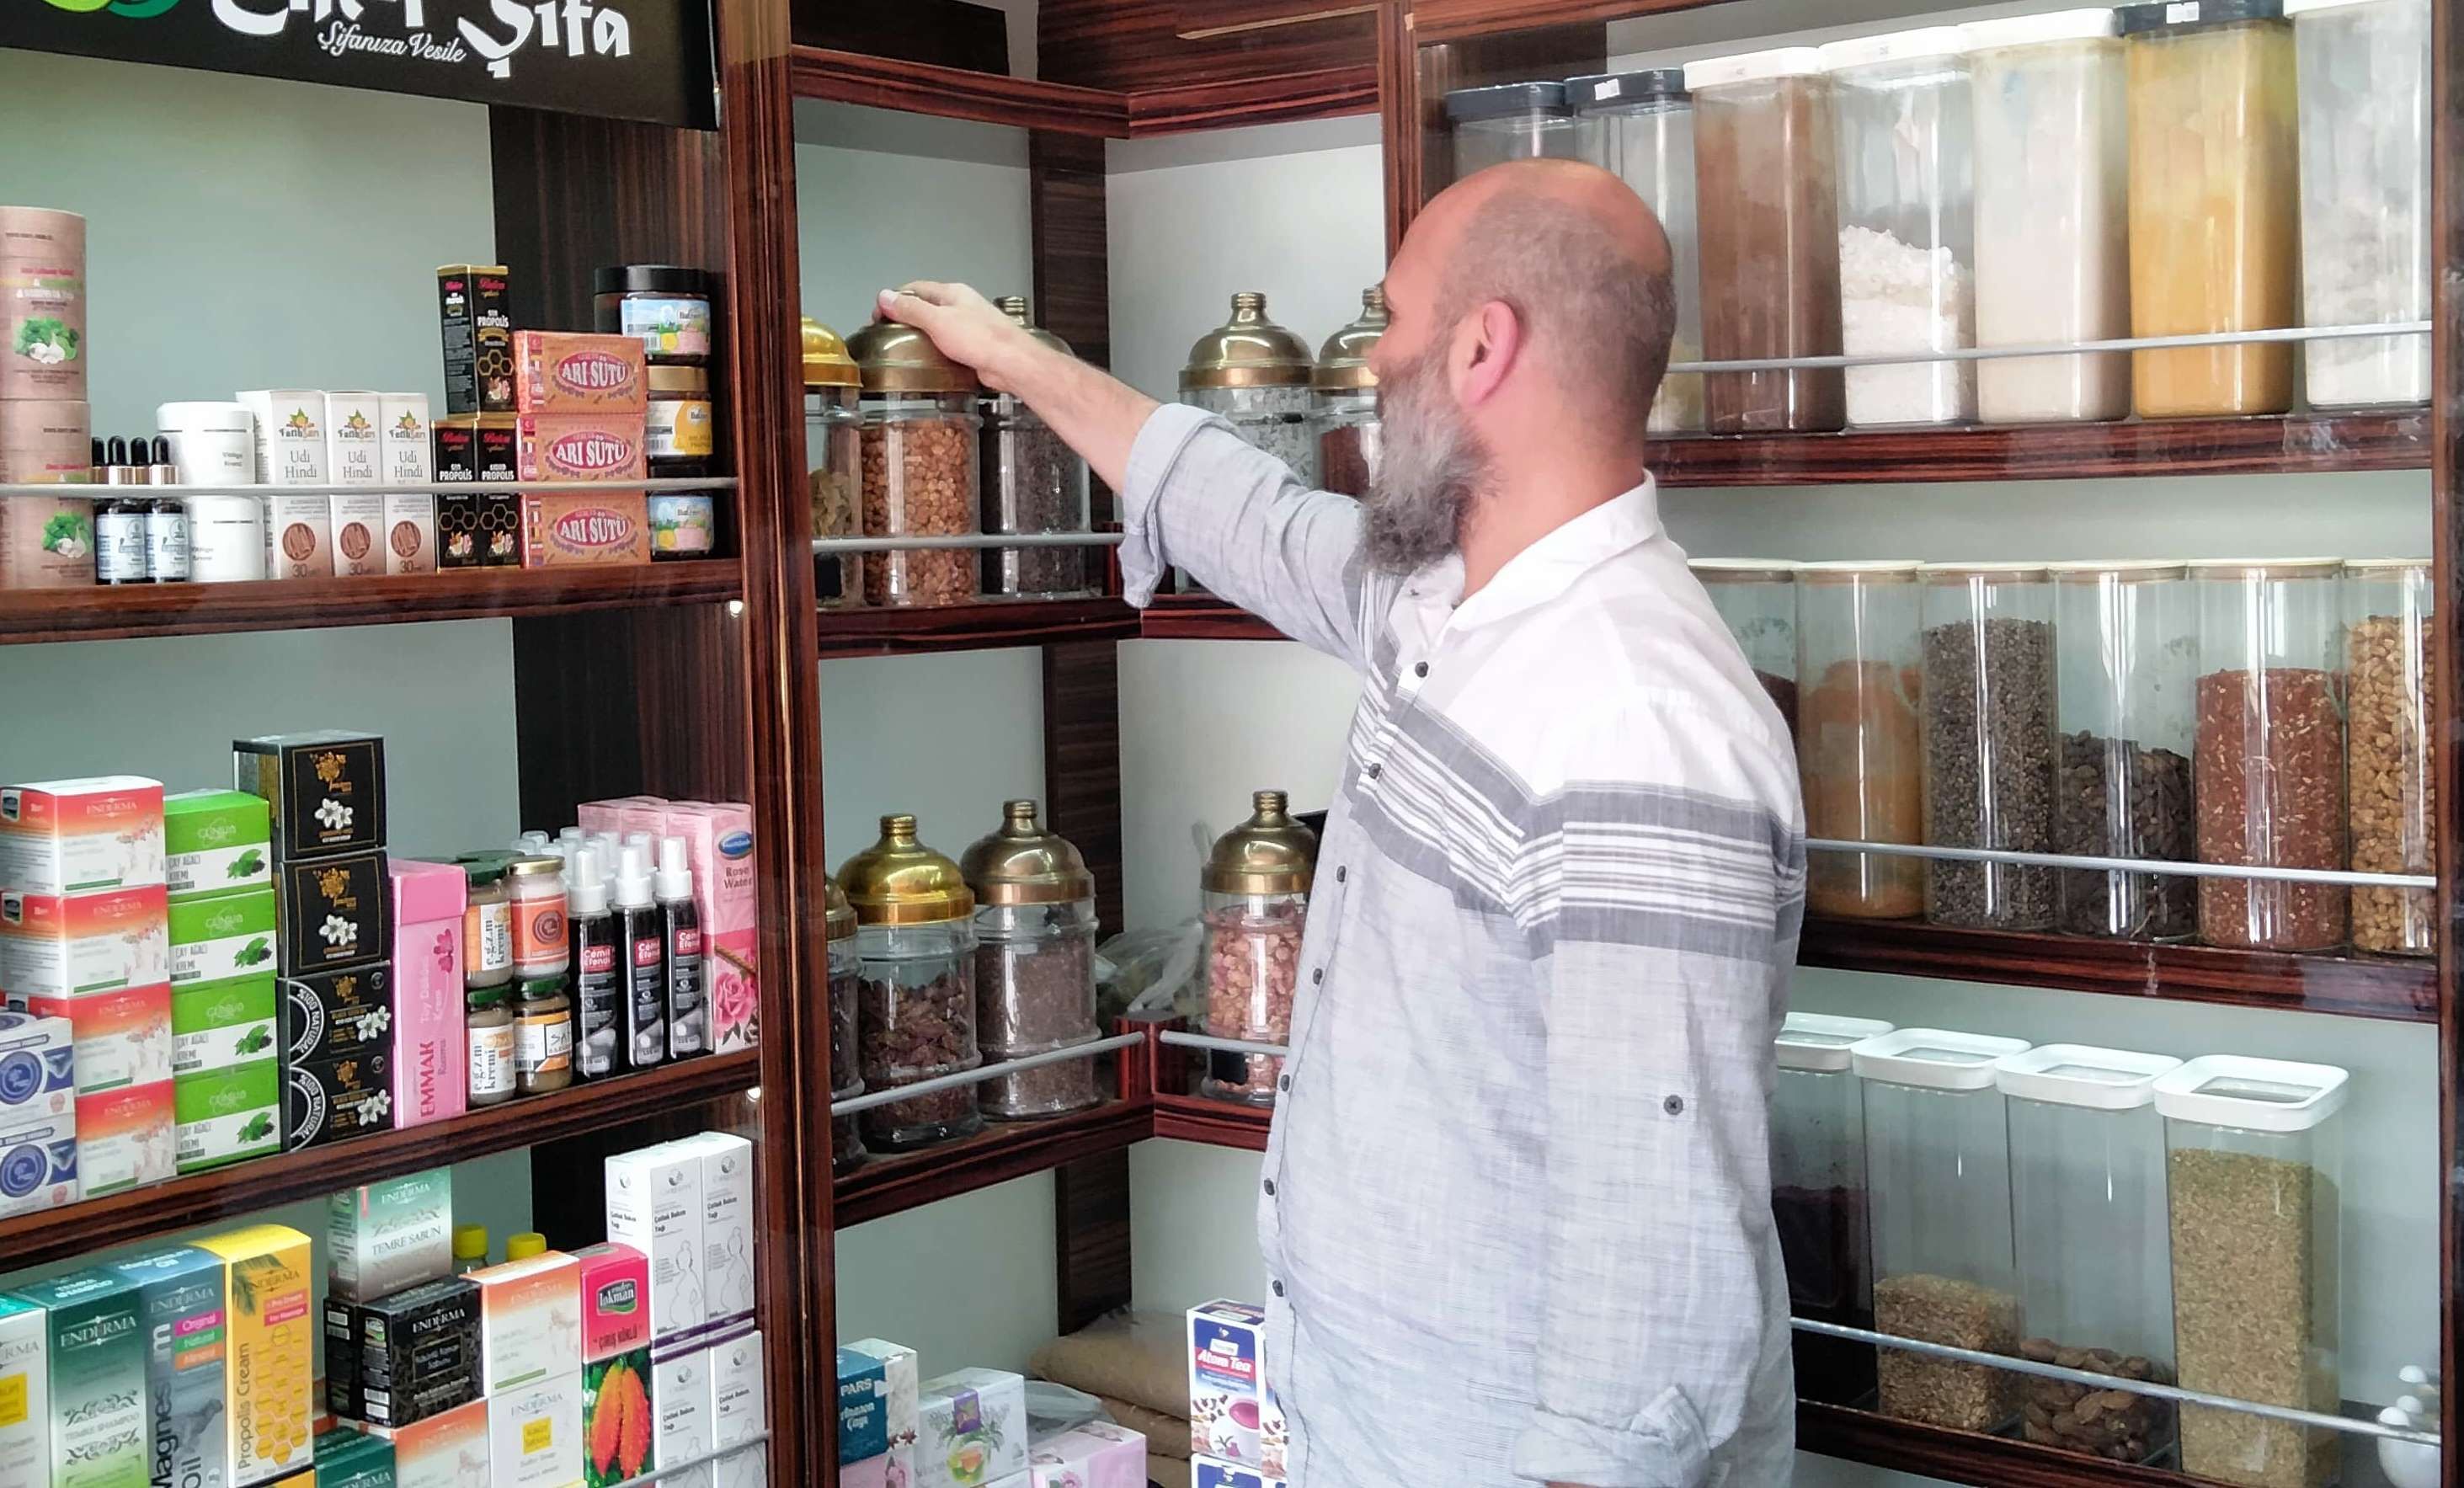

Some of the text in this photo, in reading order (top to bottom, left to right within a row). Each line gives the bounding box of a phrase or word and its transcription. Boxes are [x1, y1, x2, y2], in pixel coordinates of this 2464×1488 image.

[317, 21, 467, 63] Şifanıza Vesile
[562, 356, 627, 387] ARI SÜTÜ
[291, 450, 310, 462] Udi
[349, 451, 366, 463] Udi
[399, 451, 417, 463] Udi
[556, 436, 624, 467] ARI SÜTÜ
[285, 466, 317, 478] Hindi
[344, 467, 373, 478] Hindi
[394, 466, 423, 478] Hindi
[560, 513, 626, 543] ARI SÜTÜ
[292, 563, 307, 577] 30
[349, 563, 363, 576] 30
[400, 561, 413, 573] 30
[726, 867, 749, 877] Rose
[724, 877, 752, 889] Water
[296, 989, 320, 1053] %100 NATURAL
[420, 1041, 435, 1118] EMMAK
[298, 1074, 321, 1139] %100 NATURAL
[248, 1271, 300, 1288] NDERMA
[150, 1288, 215, 1314] ENDERMA
[600, 1288, 634, 1307] lokman
[413, 1309, 466, 1333] ENDERMA
[61, 1315, 137, 1347] ENDERMA
[840, 1378, 872, 1397] PARS
[237, 1342, 254, 1469] Propolis Cream
